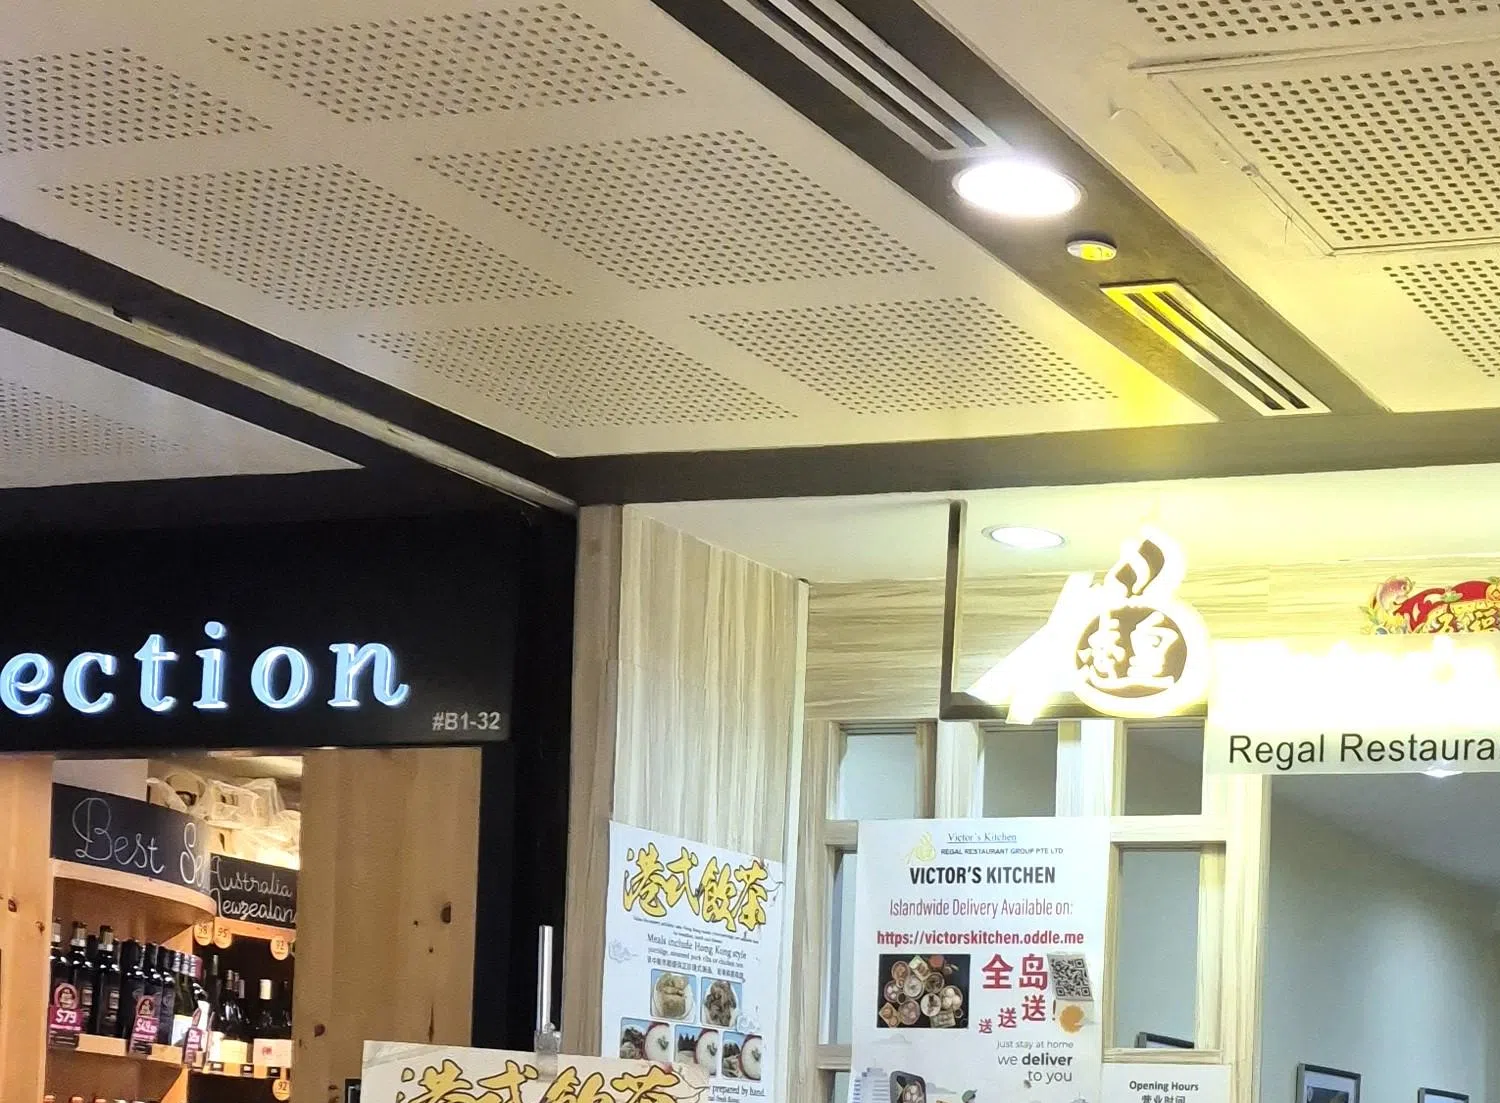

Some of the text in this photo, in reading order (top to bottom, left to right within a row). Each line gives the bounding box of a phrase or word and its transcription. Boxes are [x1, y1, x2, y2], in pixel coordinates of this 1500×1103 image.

[431, 711, 501, 732] #B1-32
[1228, 733, 1324, 770] Regal
[71, 797, 165, 874] Best
[983, 831, 1018, 841] Kitchen
[940, 846, 1064, 855] REGAL RESTAURANT GROUP PTE LTD
[209, 855, 293, 898] Australia
[909, 865, 1056, 885] VICTOR'S KITCHEN
[621, 842, 768, 932] 港式飲茶
[209, 887, 297, 922] Newzealan
[889, 898, 1074, 920] Islandwide Delivery Available on:
[876, 929, 1085, 947] https://victorskitchen.oddle.me
[981, 952, 1048, 991] 全岛
[997, 1040, 1074, 1050] Just stay at home
[997, 1052, 1073, 1067] we deliver
[1028, 1070, 1073, 1085] to you
[1129, 1080, 1199, 1092] Opening Hours
